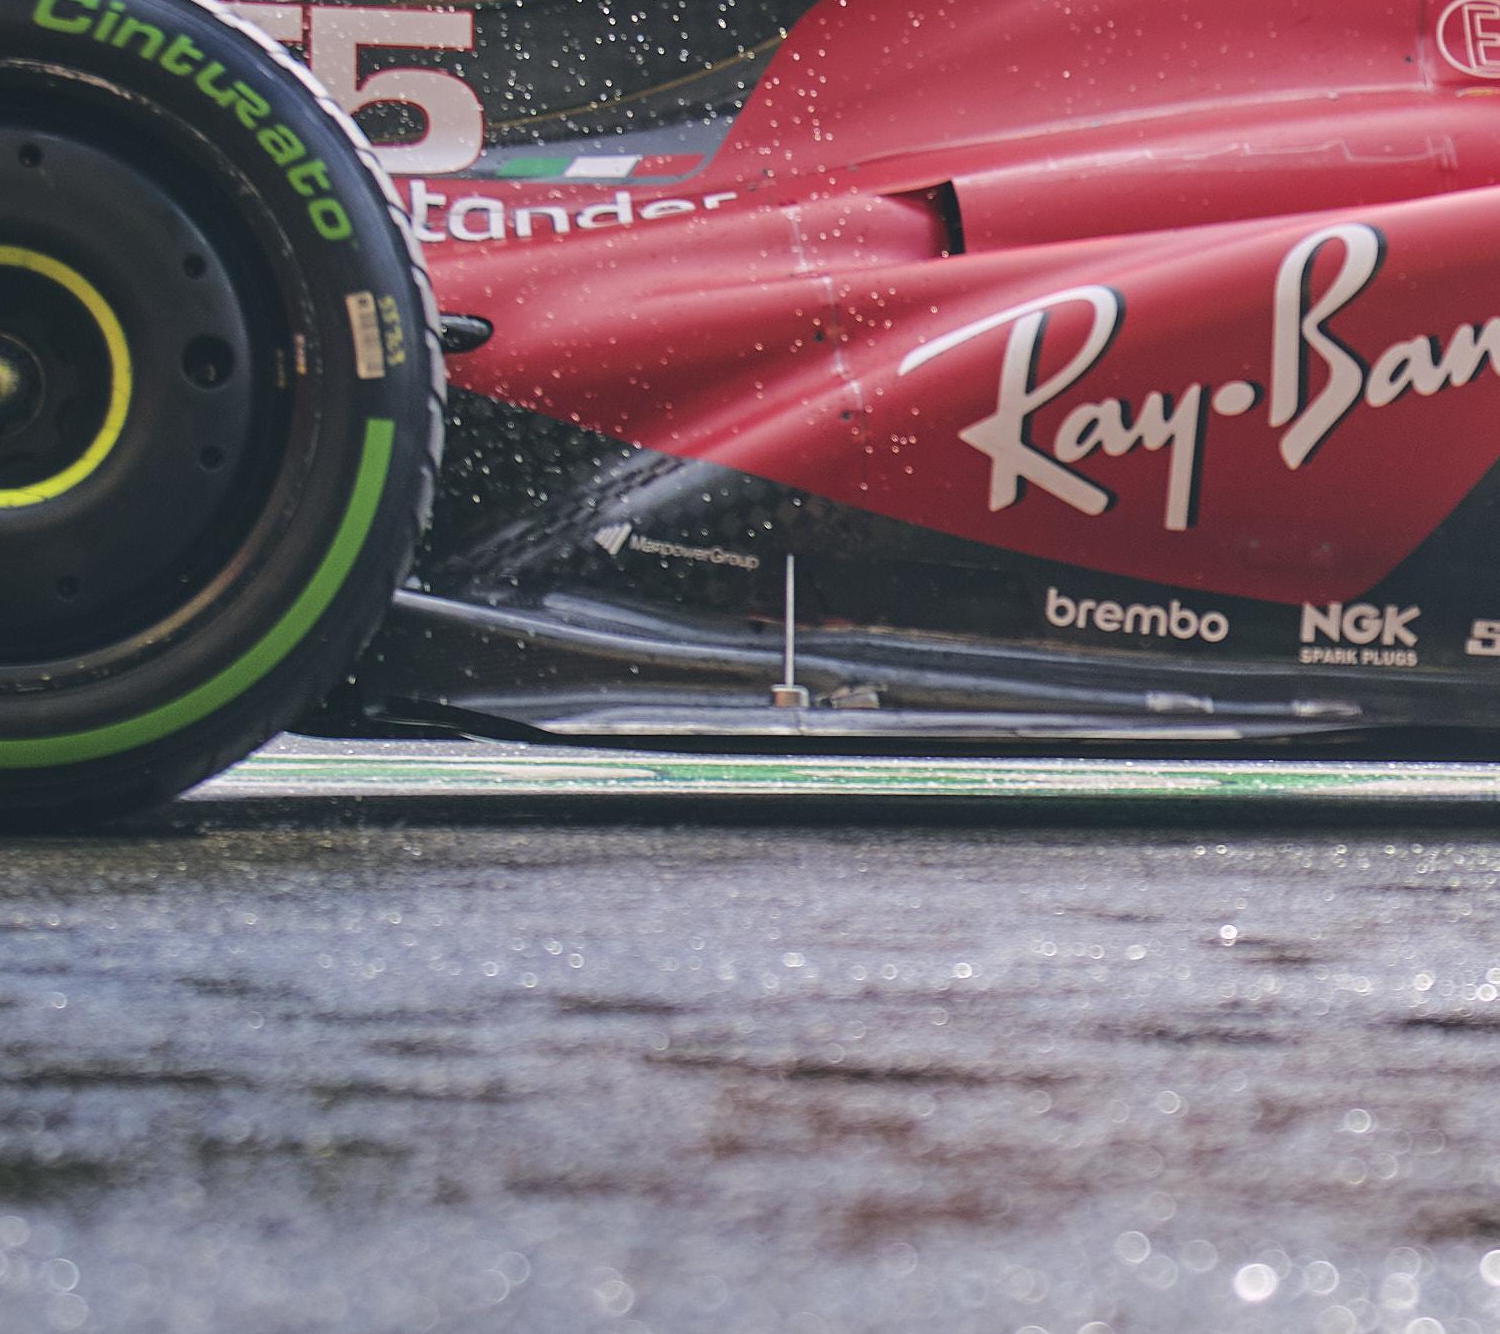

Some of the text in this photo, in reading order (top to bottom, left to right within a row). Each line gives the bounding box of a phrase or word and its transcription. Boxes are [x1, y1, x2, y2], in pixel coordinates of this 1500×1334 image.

[219, 0, 485, 175] 5
[1046, 586, 1230, 643] brembo
[1300, 601, 1422, 647] NGK
[1300, 646, 1419, 668] SPARK PLUGS
